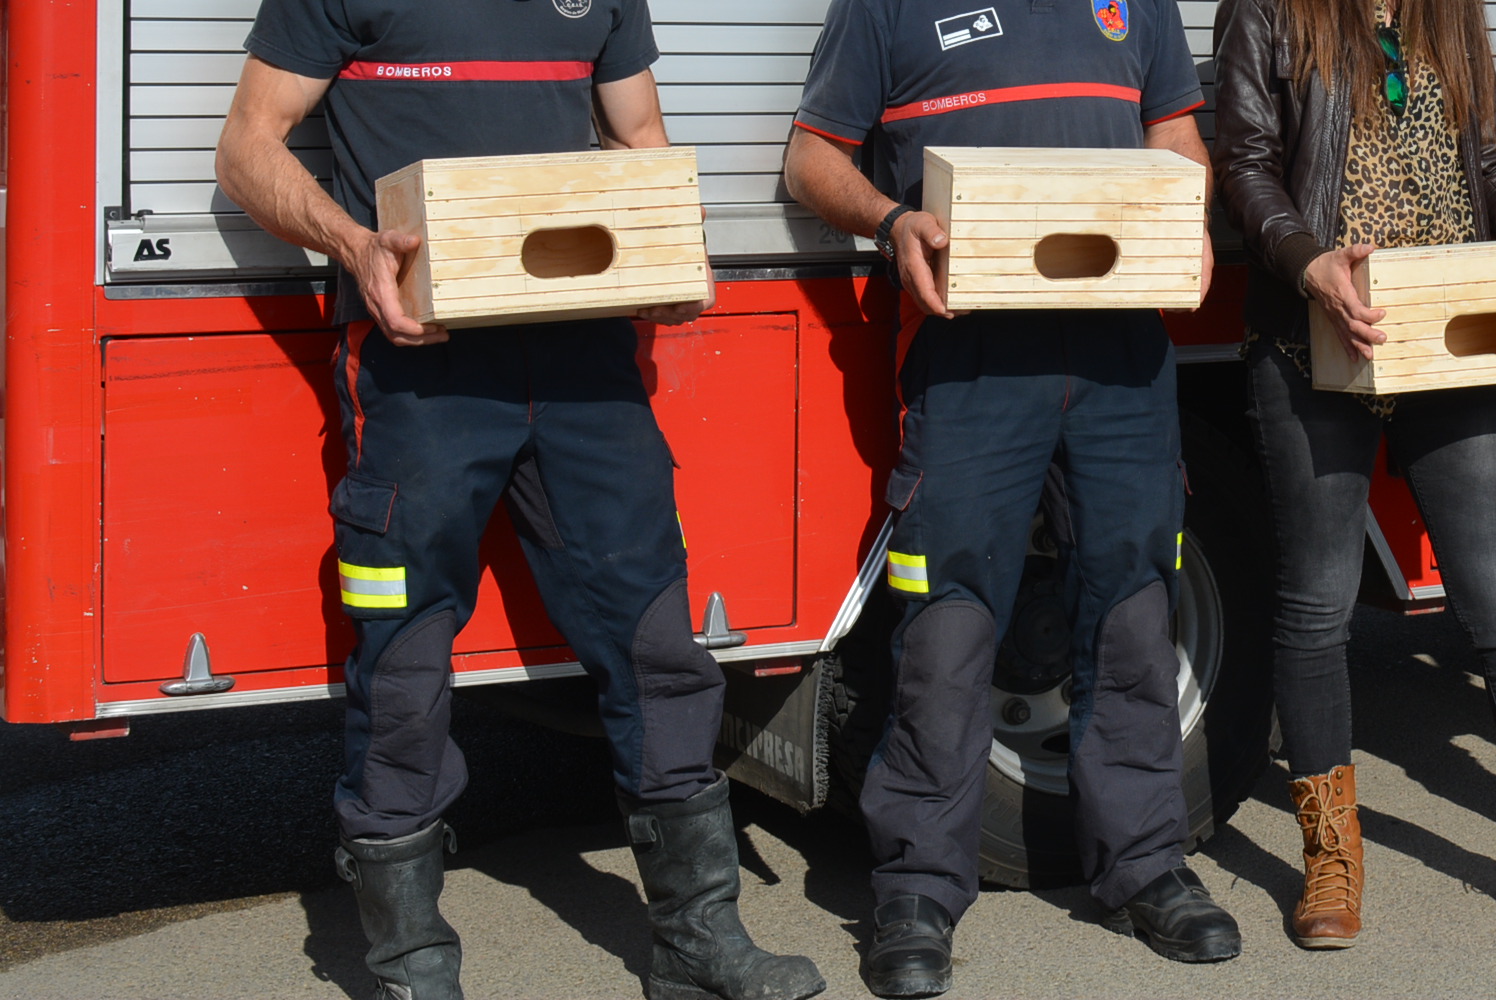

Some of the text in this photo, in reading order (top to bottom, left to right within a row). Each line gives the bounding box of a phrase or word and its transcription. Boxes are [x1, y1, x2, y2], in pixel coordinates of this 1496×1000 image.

[376, 65, 453, 78] BOMBEROS
[922, 92, 987, 112] BOMBEROS
[133, 238, 172, 262] AS
